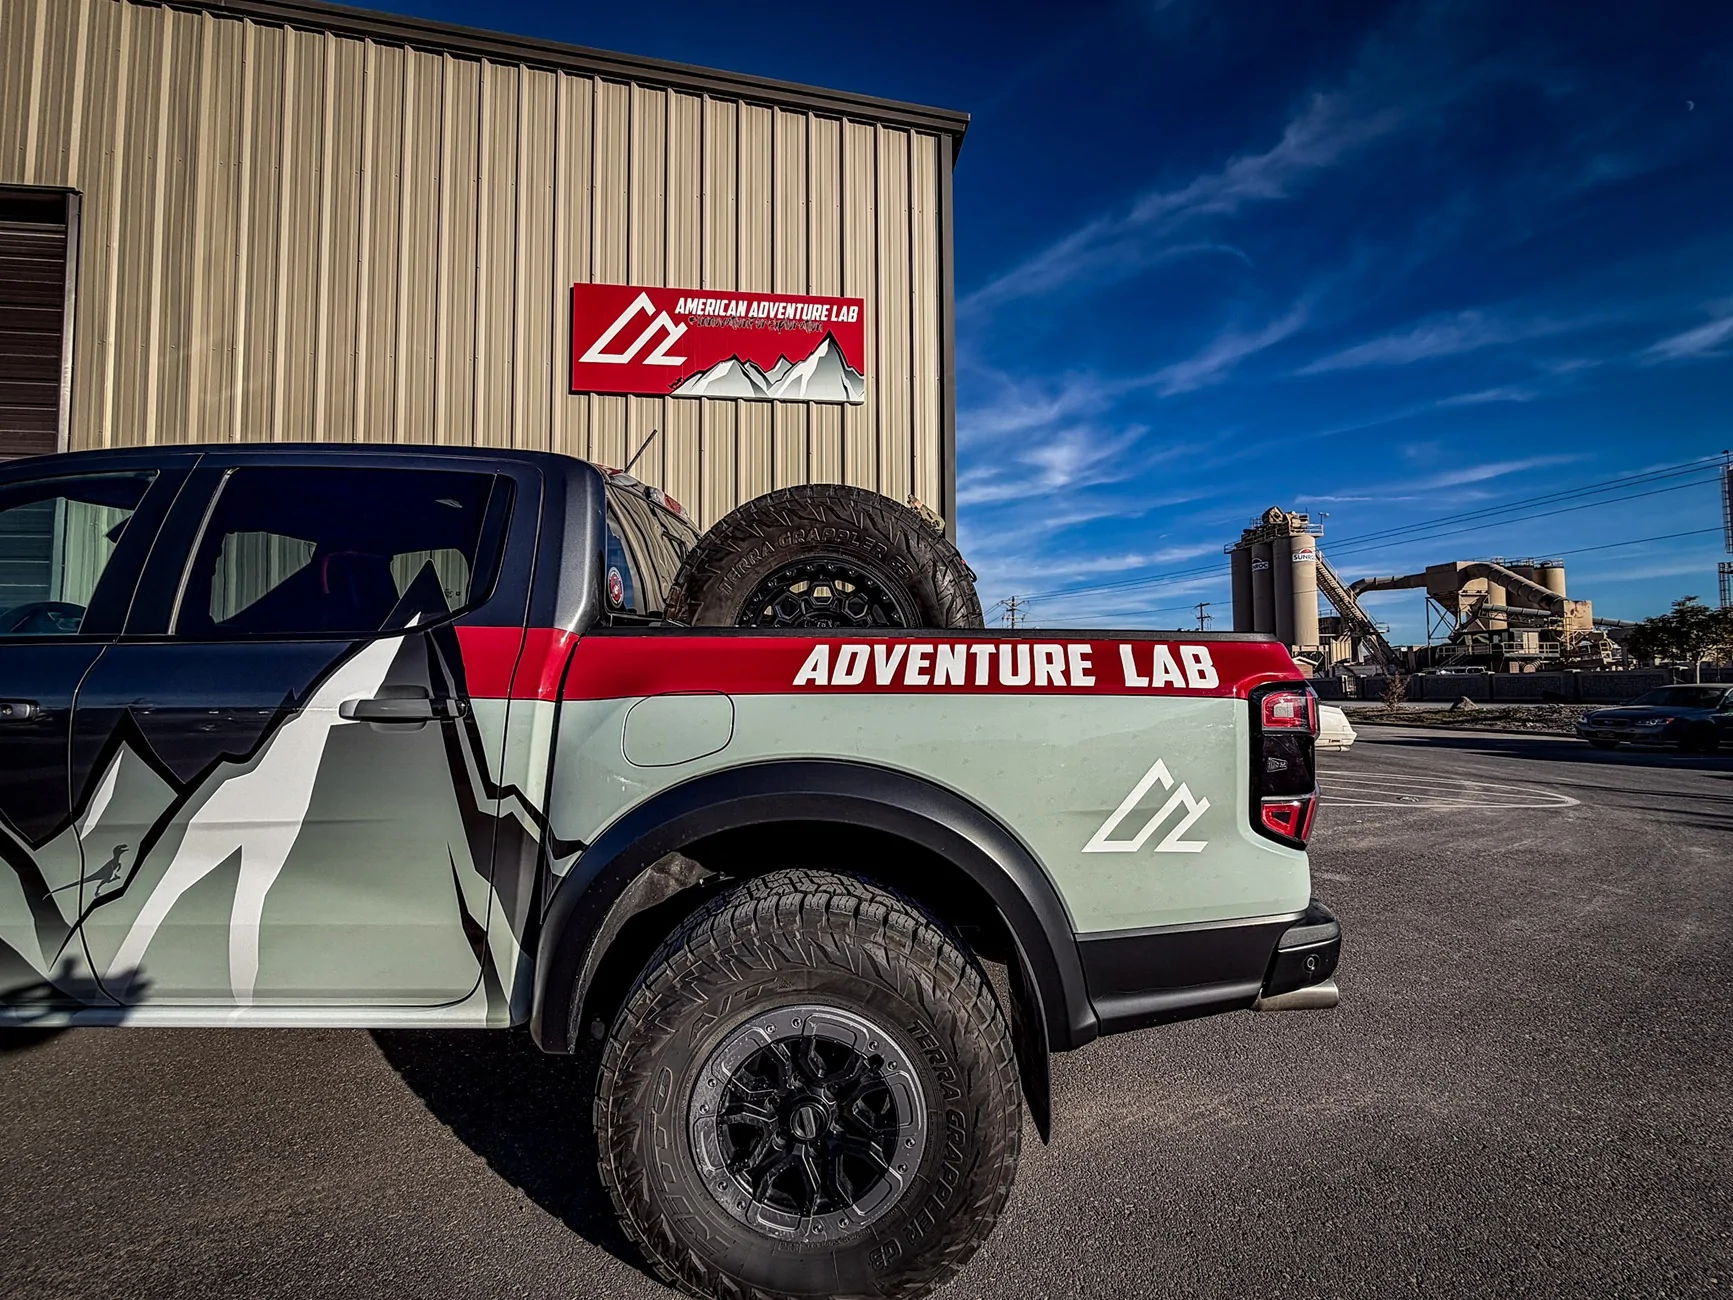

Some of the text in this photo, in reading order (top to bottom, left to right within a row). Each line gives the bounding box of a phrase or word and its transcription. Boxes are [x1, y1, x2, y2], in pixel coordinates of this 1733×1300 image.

[674, 297, 859, 323] AMERICAN ADVENTURE LAB
[717, 541, 775, 596] TERRA
[778, 528, 889, 559] GRAPPLER
[793, 644, 1220, 689] ADVENTURE LAB
[906, 1019, 961, 1100] TERRA
[906, 1108, 966, 1248] GRAPPLER
